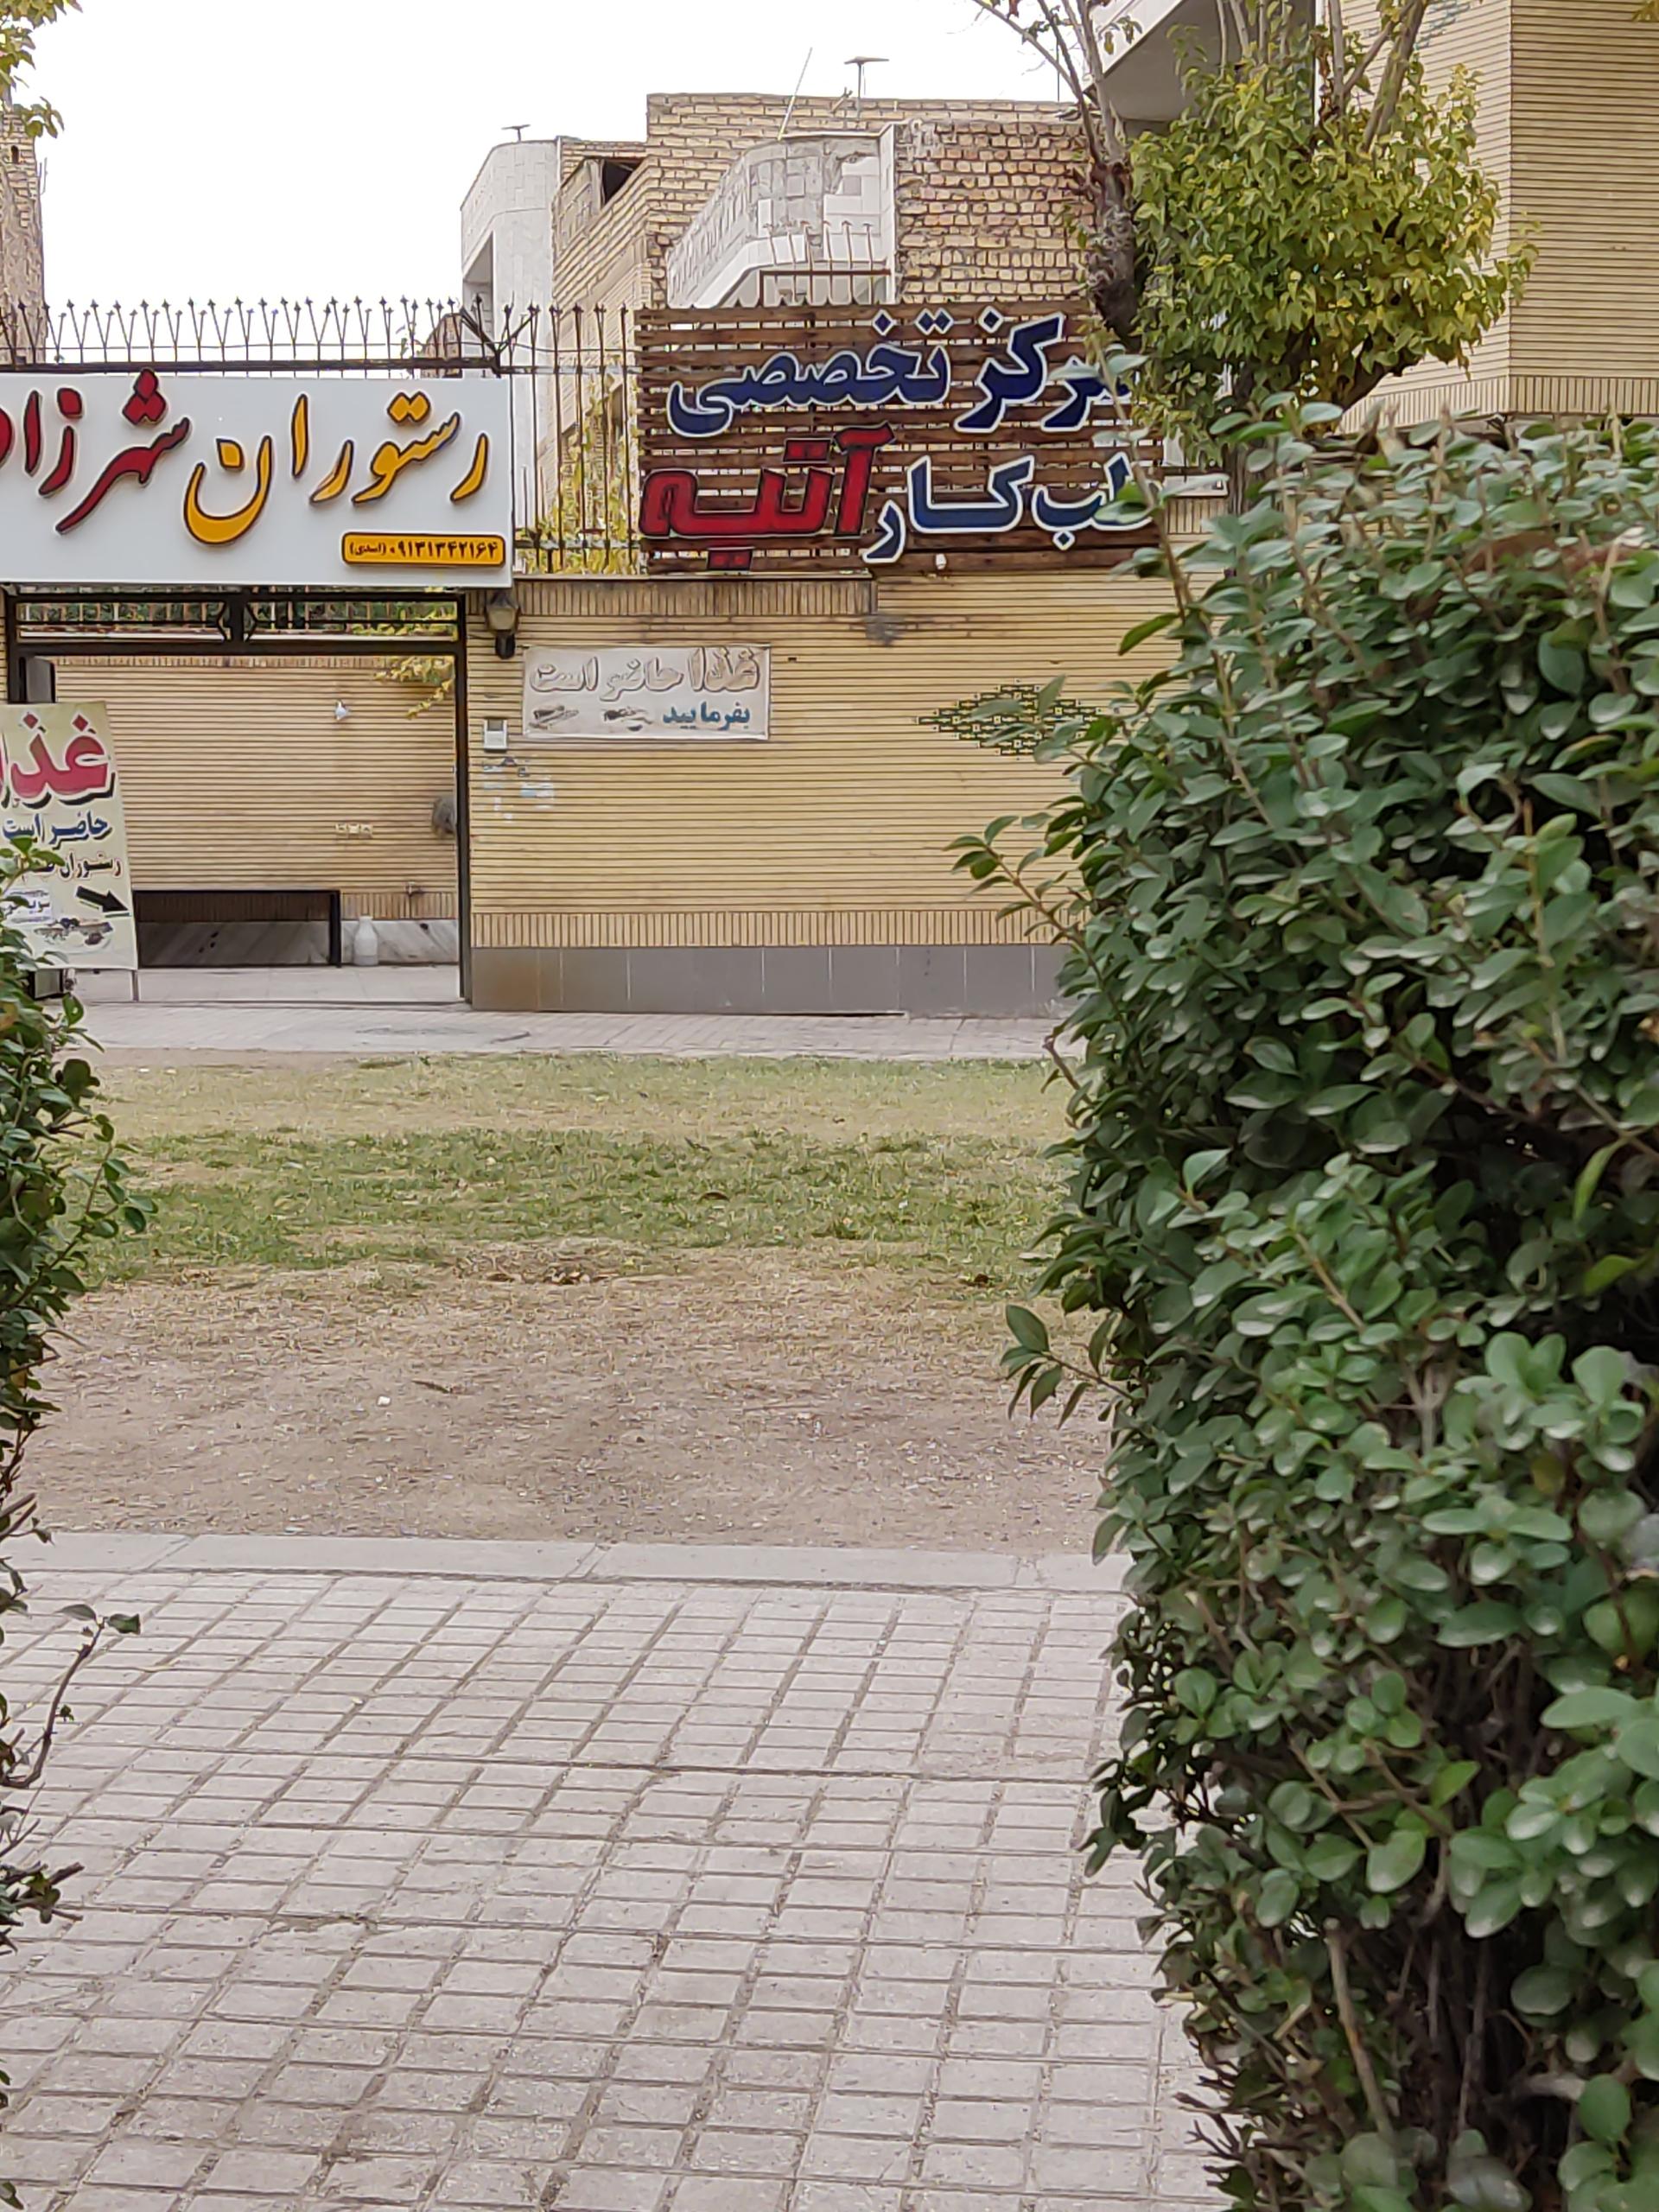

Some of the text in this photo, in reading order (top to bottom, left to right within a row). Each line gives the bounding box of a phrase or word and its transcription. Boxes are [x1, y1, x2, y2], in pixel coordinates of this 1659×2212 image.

[668, 308, 952, 437] تخصصی
[184, 391, 491, 545] رستوران
[639, 423, 896, 572] آتیه
[862, 455, 1035, 563] کار
[529, 645, 761, 702] غذا حاضر است
[0, 713, 109, 800] غذ
[2, 810, 108, 846] حاضر است
